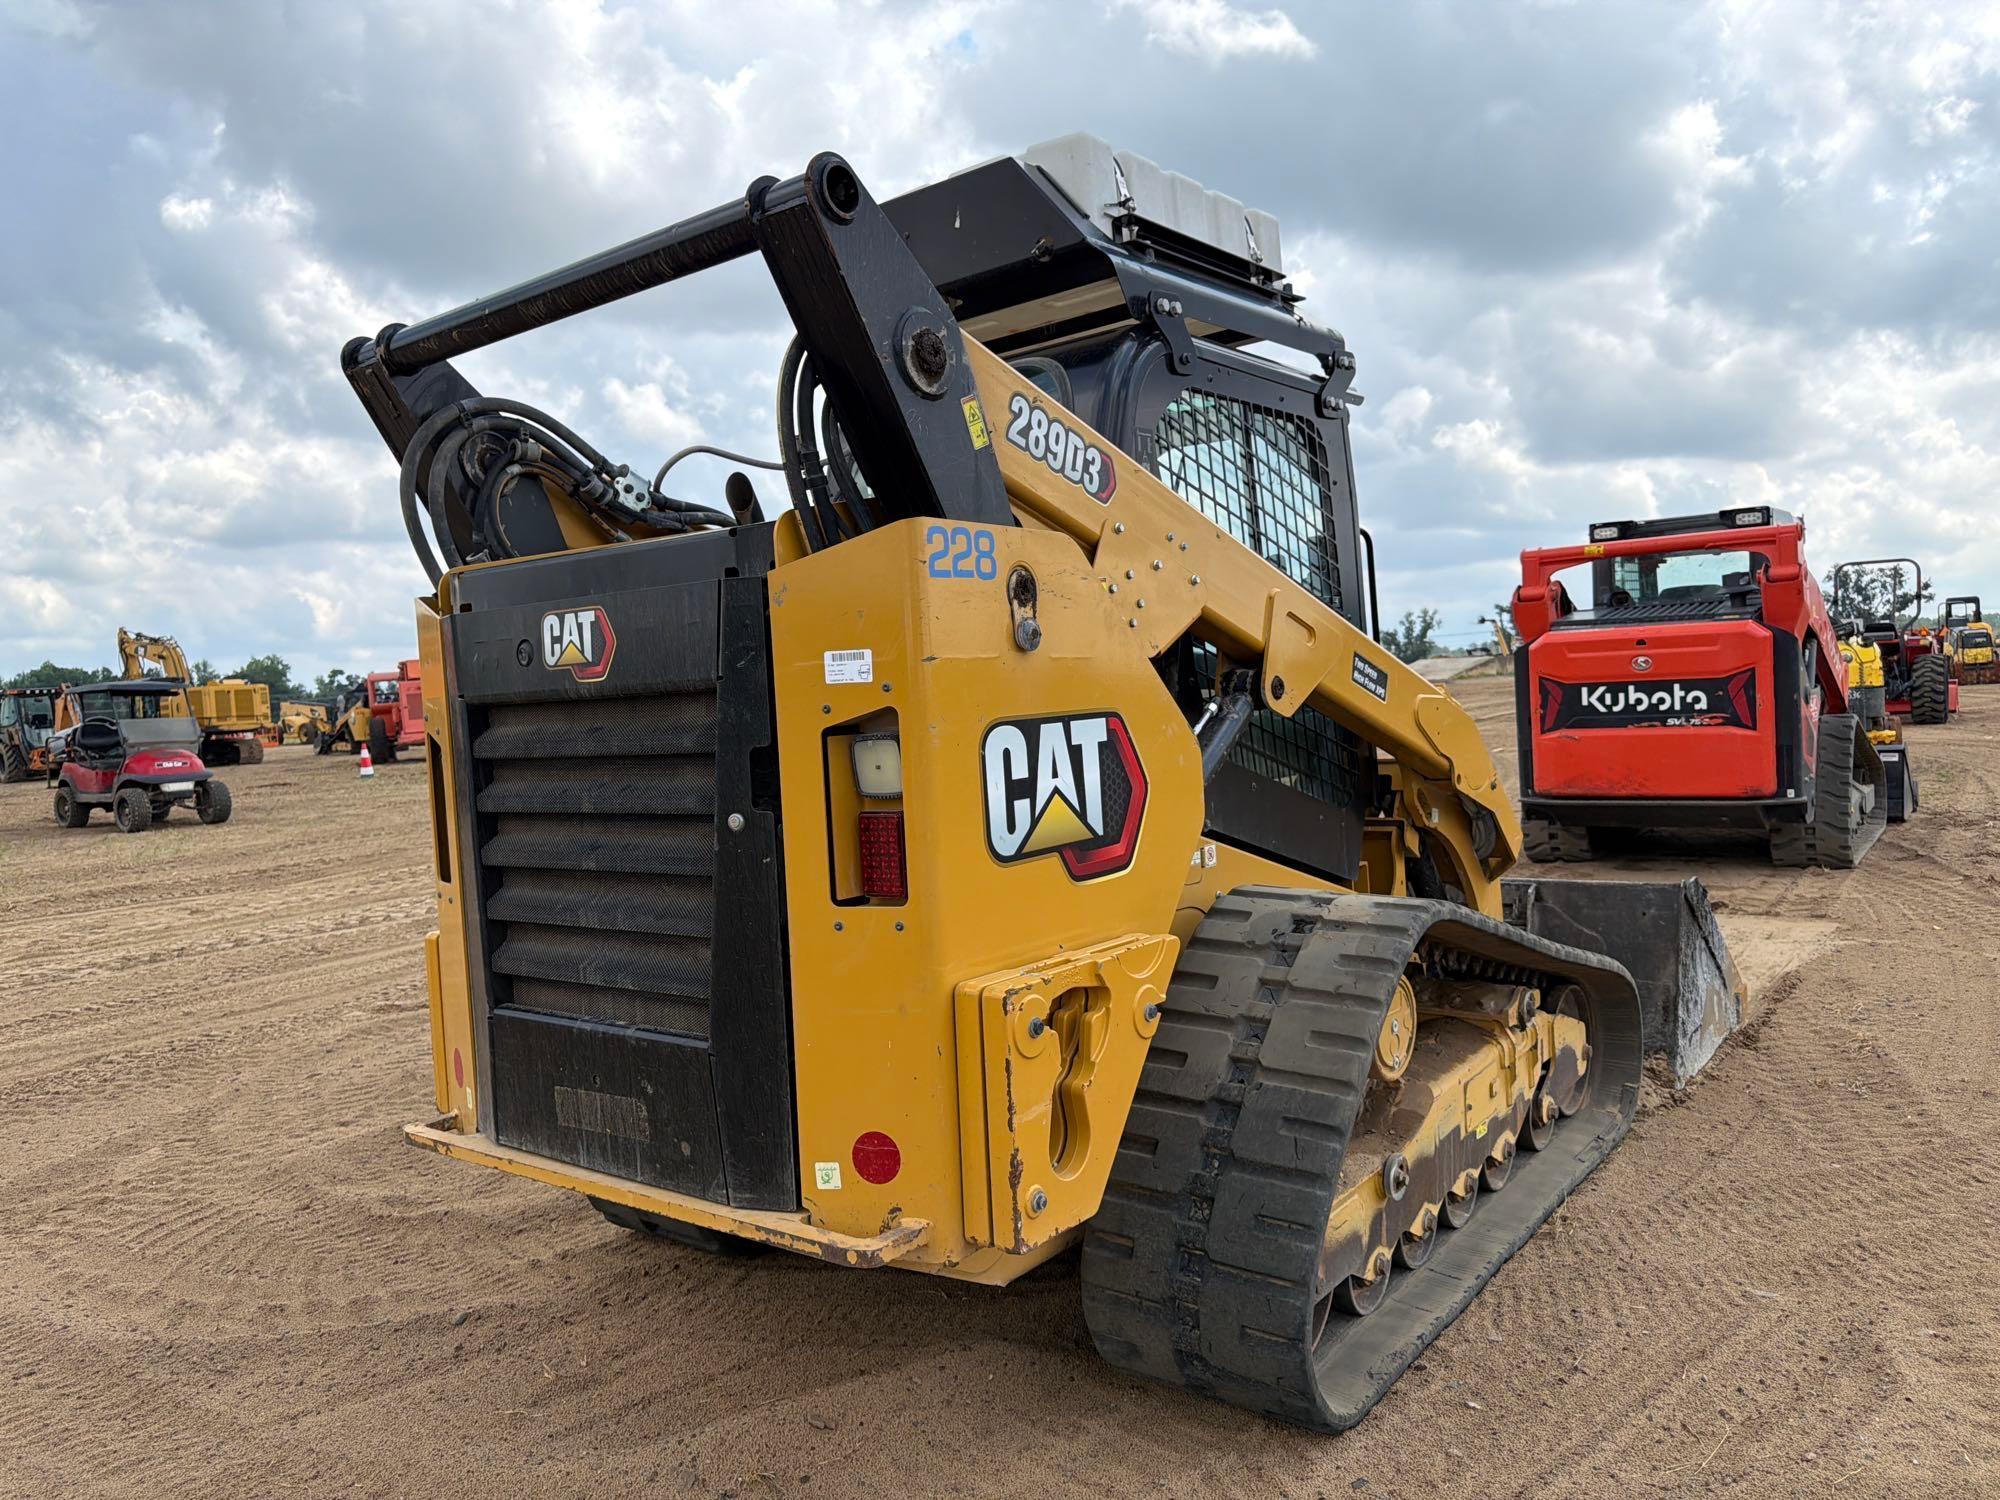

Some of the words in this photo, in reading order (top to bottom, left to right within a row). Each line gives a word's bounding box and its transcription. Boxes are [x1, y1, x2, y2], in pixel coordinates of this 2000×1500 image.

[1008, 395, 1101, 494] 289D3
[926, 525, 997, 581] 228
[543, 610, 595, 667] CAT
[1581, 683, 1708, 713] Kubota
[984, 718, 1108, 857] CAT
